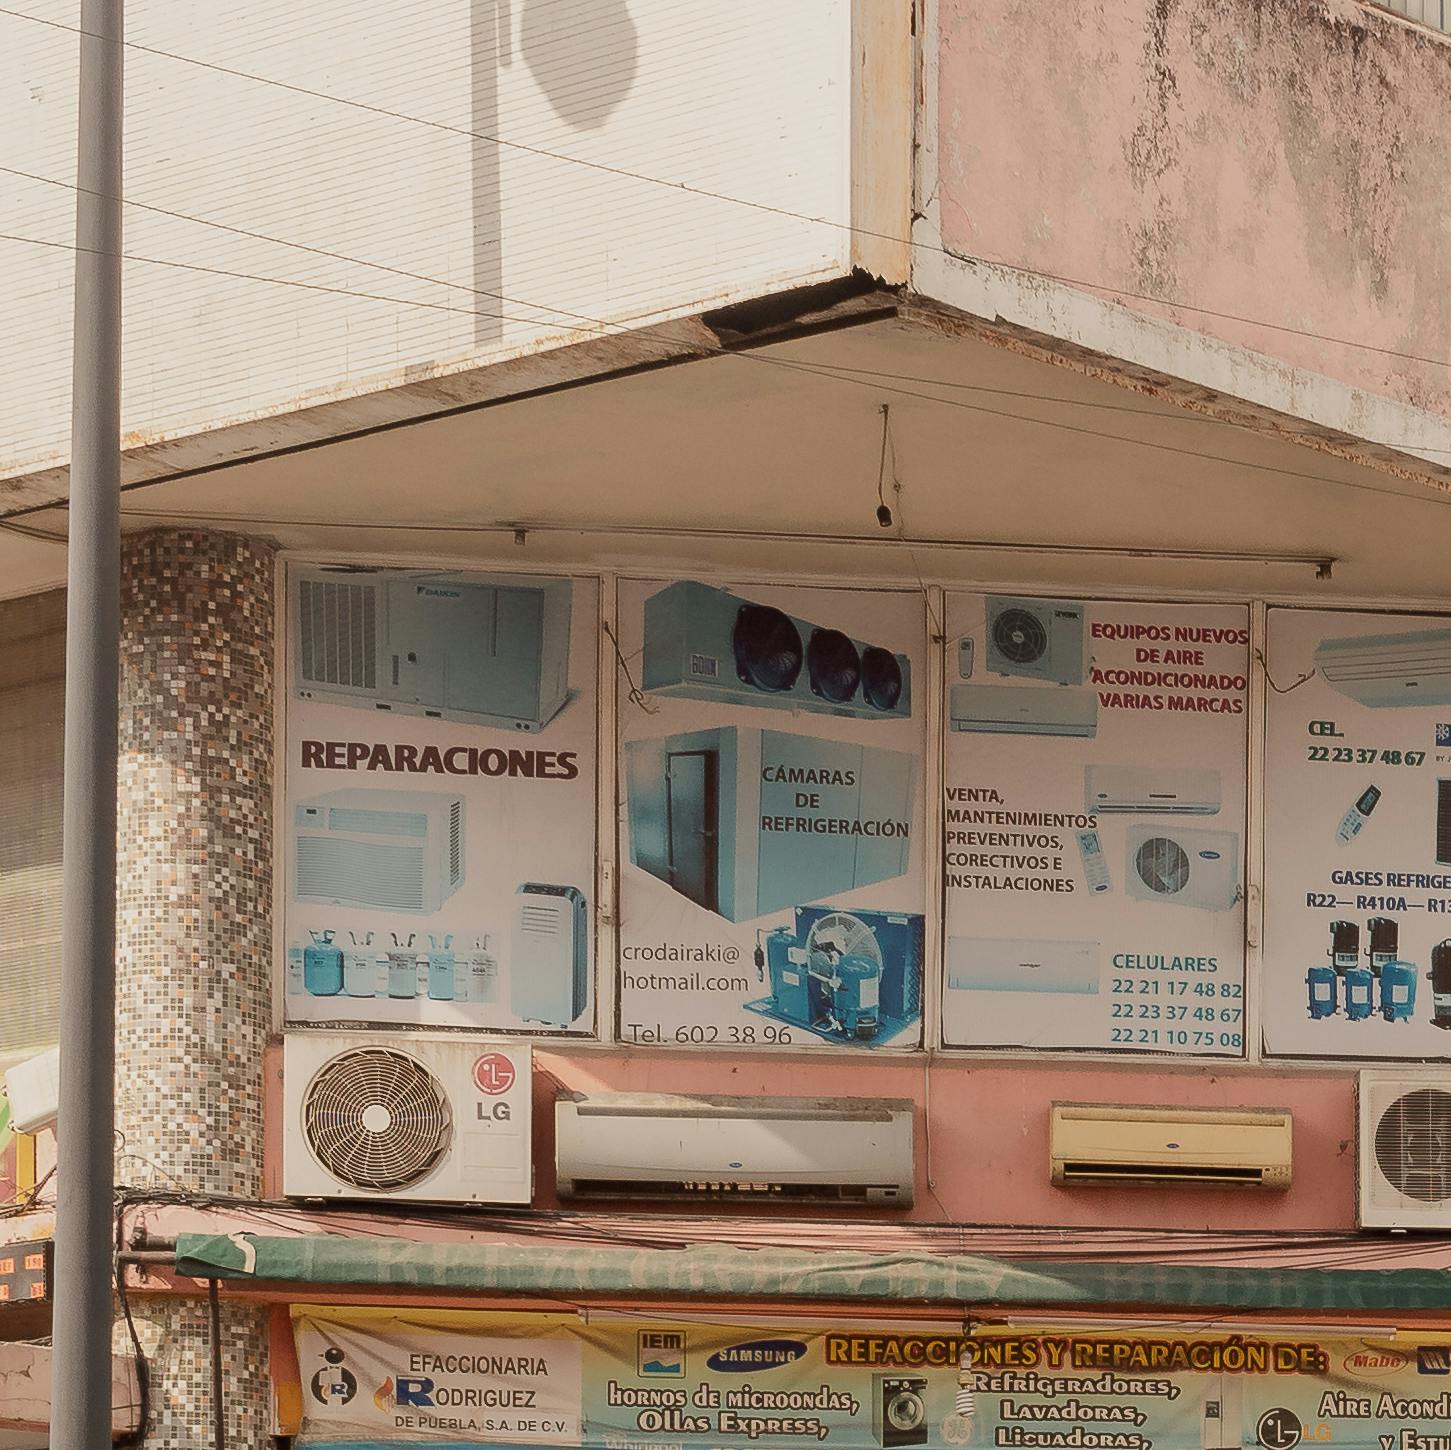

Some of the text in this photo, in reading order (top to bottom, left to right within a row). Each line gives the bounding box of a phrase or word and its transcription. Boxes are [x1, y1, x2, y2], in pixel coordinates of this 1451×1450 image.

[1091, 622, 1249, 645] EQUIPOS NUEVOS
[1135, 648, 1205, 666] DE AIRE
[1091, 669, 1247, 691] ACONDICIONADO
[1098, 692, 1244, 714] VARIAS MARCAS
[301, 740, 579, 780] REPARACIONES
[1307, 746, 1426, 767] 22 23 37 48 67
[1435, 755, 1445, 763] BY
[761, 765, 855, 786] CÁMARAS
[795, 792, 820, 809] DE
[946, 787, 1005, 805] VENTA,
[761, 815, 910, 839] REFRIGERACIÓN
[946, 809, 1098, 829] MANTENIMIENTOS
[946, 831, 1064, 851] PREVENTIVOS,
[946, 853, 1063, 871] CORECTIVOS E
[946, 874, 1075, 893] INSTALACIONES
[1331, 870, 1384, 887] GASES
[622, 943, 741, 964] crodairaki@
[1112, 953, 1218, 973] CELULARES
[622, 971, 750, 993] hotmail.com
[1112, 979, 1242, 999] 22 21 17 48 82
[1112, 1003, 1242, 1023] 22 23 37 48 67
[628, 1023, 793, 1045] Tel. 602 38 96
[1112, 1028, 1242, 1048] 22 21 10 75 08
[477, 1102, 511, 1121] LG
[642, 1333, 682, 1349] IEM
[718, 1349, 797, 1363] SAMSUNG
[829, 1336, 1327, 1372] REFACCIONES Y REPARACIÓN DE:
[1352, 1353, 1401, 1369] Mabe
[409, 1353, 549, 1376] EFACCIONARIA
[395, 1374, 537, 1409] RODRIGUEZ
[395, 1416, 568, 1433] DE PUEBLA, S.A. DE C.V.
[1303, 1423, 1333, 1441] LG
